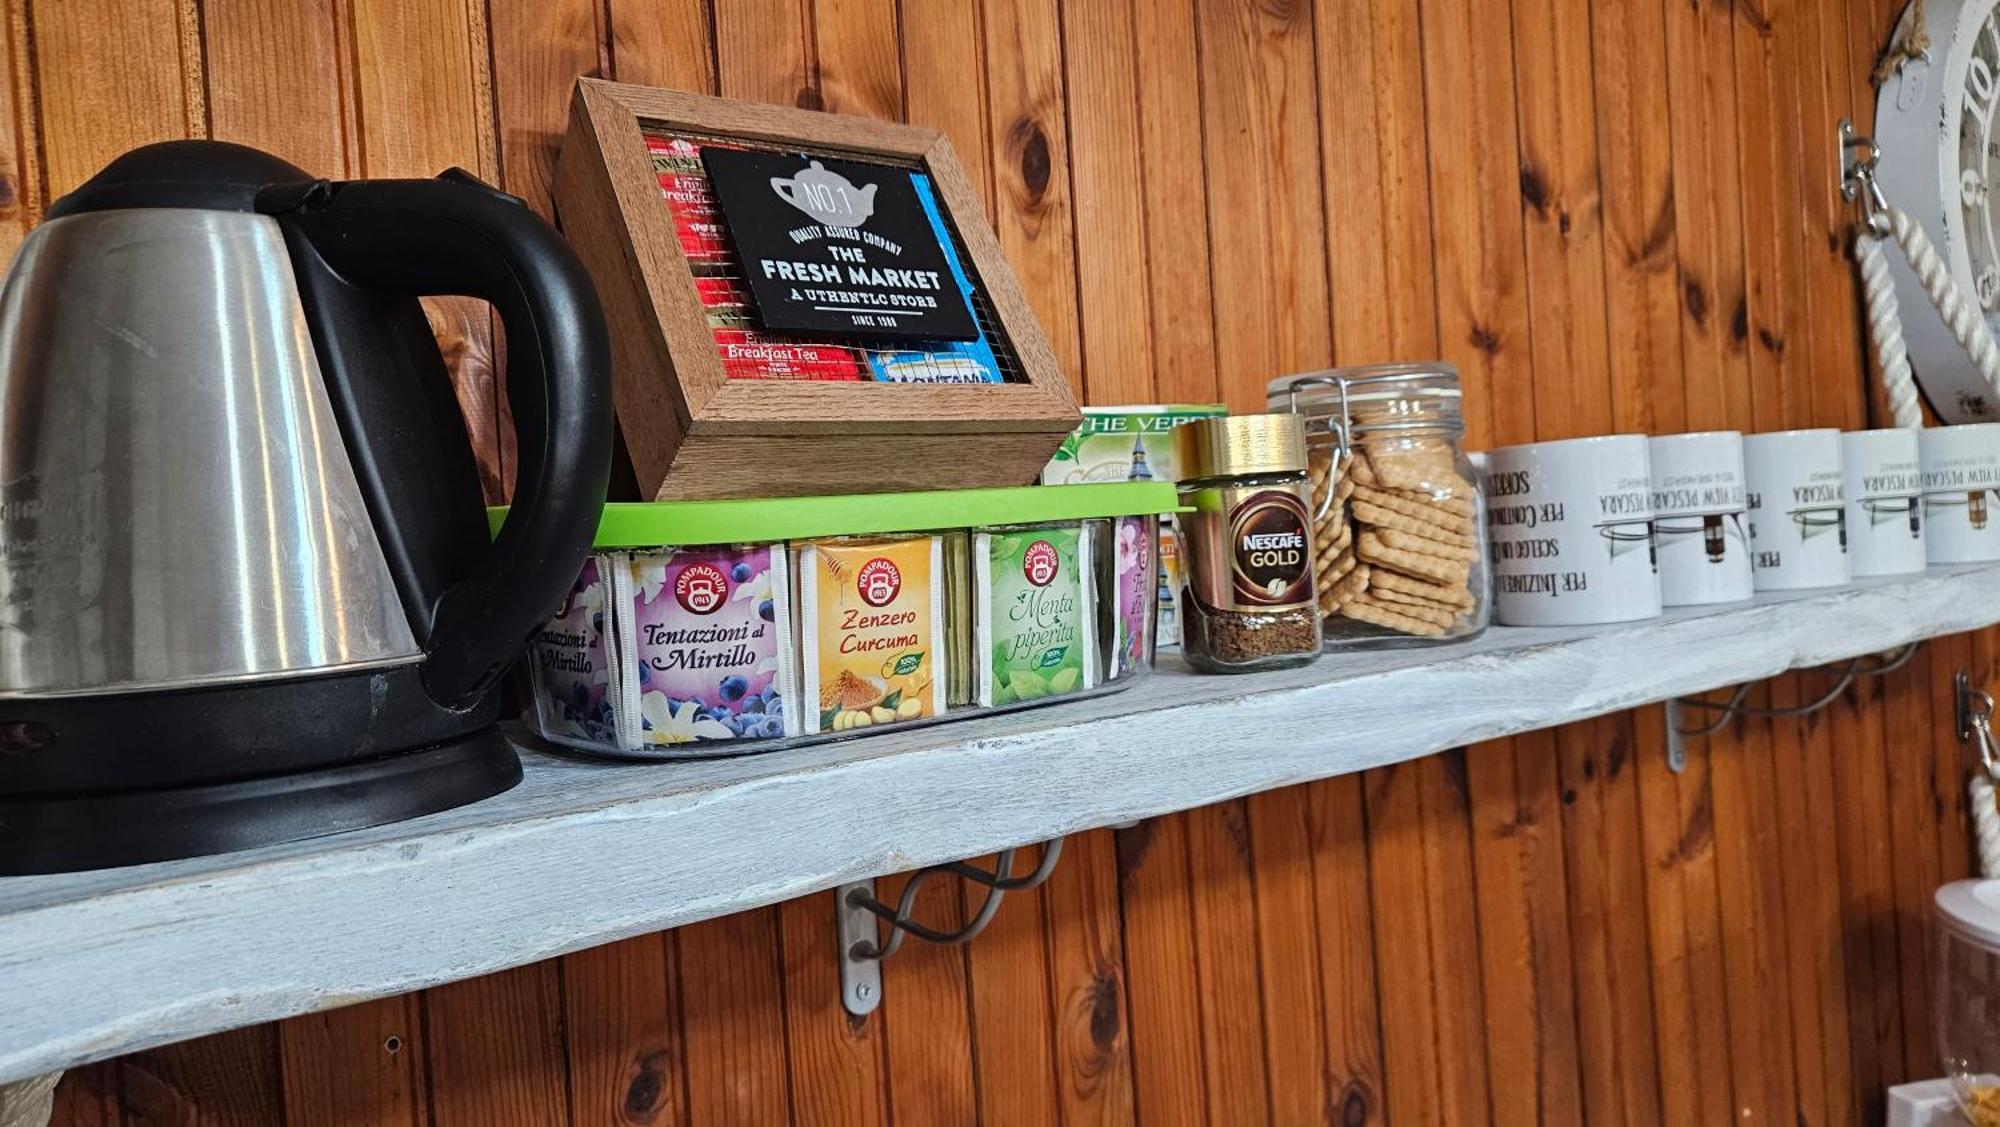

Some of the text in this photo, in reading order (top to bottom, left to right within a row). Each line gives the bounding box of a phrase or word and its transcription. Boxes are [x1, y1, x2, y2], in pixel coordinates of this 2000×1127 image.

[802, 182, 853, 214] NO.1
[788, 225, 902, 256] QUALITY ASSURED COMPANY
[827, 246, 867, 263] THE
[760, 259, 941, 291] FRESH MARKET
[890, 295, 938, 308] STORE
[851, 314, 876, 327] SINCE
[727, 344, 818, 361] Breakfast Tea
[1539, 502, 1564, 523] PER
[1024, 543, 1058, 569] POMPADOUR
[1250, 550, 1300, 567] GOLD
[677, 566, 726, 594] POMPADOUR
[859, 560, 899, 588] POMPADOUR
[1562, 574, 1587, 591] PER
[841, 609, 916, 630] Zenzero
[1009, 585, 1073, 628] Menta
[643, 620, 765, 646] Tentazioni al
[839, 633, 918, 654] Curcuma
[1005, 622, 1074, 662] piperita
[651, 644, 756, 671] Mirtillo
